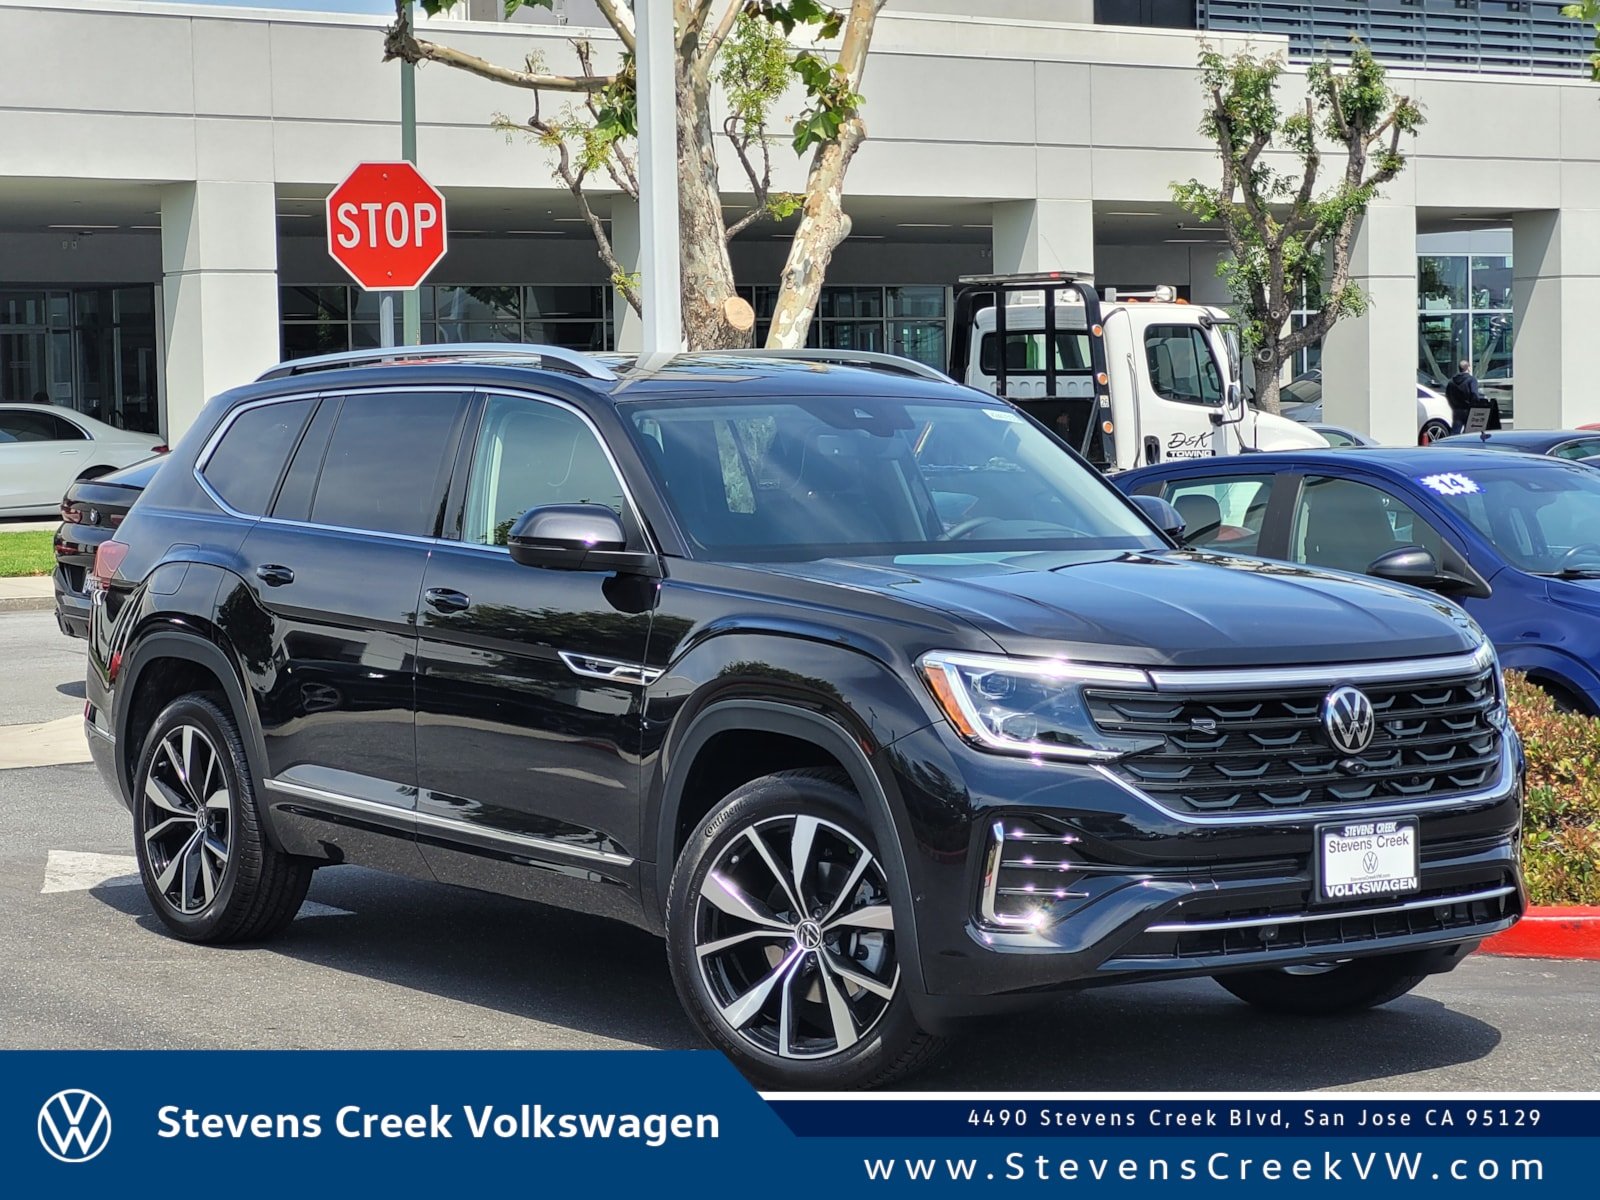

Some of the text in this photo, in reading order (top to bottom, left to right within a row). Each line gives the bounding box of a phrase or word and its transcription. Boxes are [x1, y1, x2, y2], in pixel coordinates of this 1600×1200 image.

[337, 202, 437, 249] STOP
[1169, 450, 1212, 458] TOWING
[1438, 477, 1465, 490] 14
[1326, 686, 1375, 755] VW
[1344, 821, 1398, 837] STEVENS CREEK
[1328, 832, 1410, 854] Stevens Creek
[1362, 851, 1379, 874] VW
[1326, 877, 1418, 898] VOLKSWAGEN
